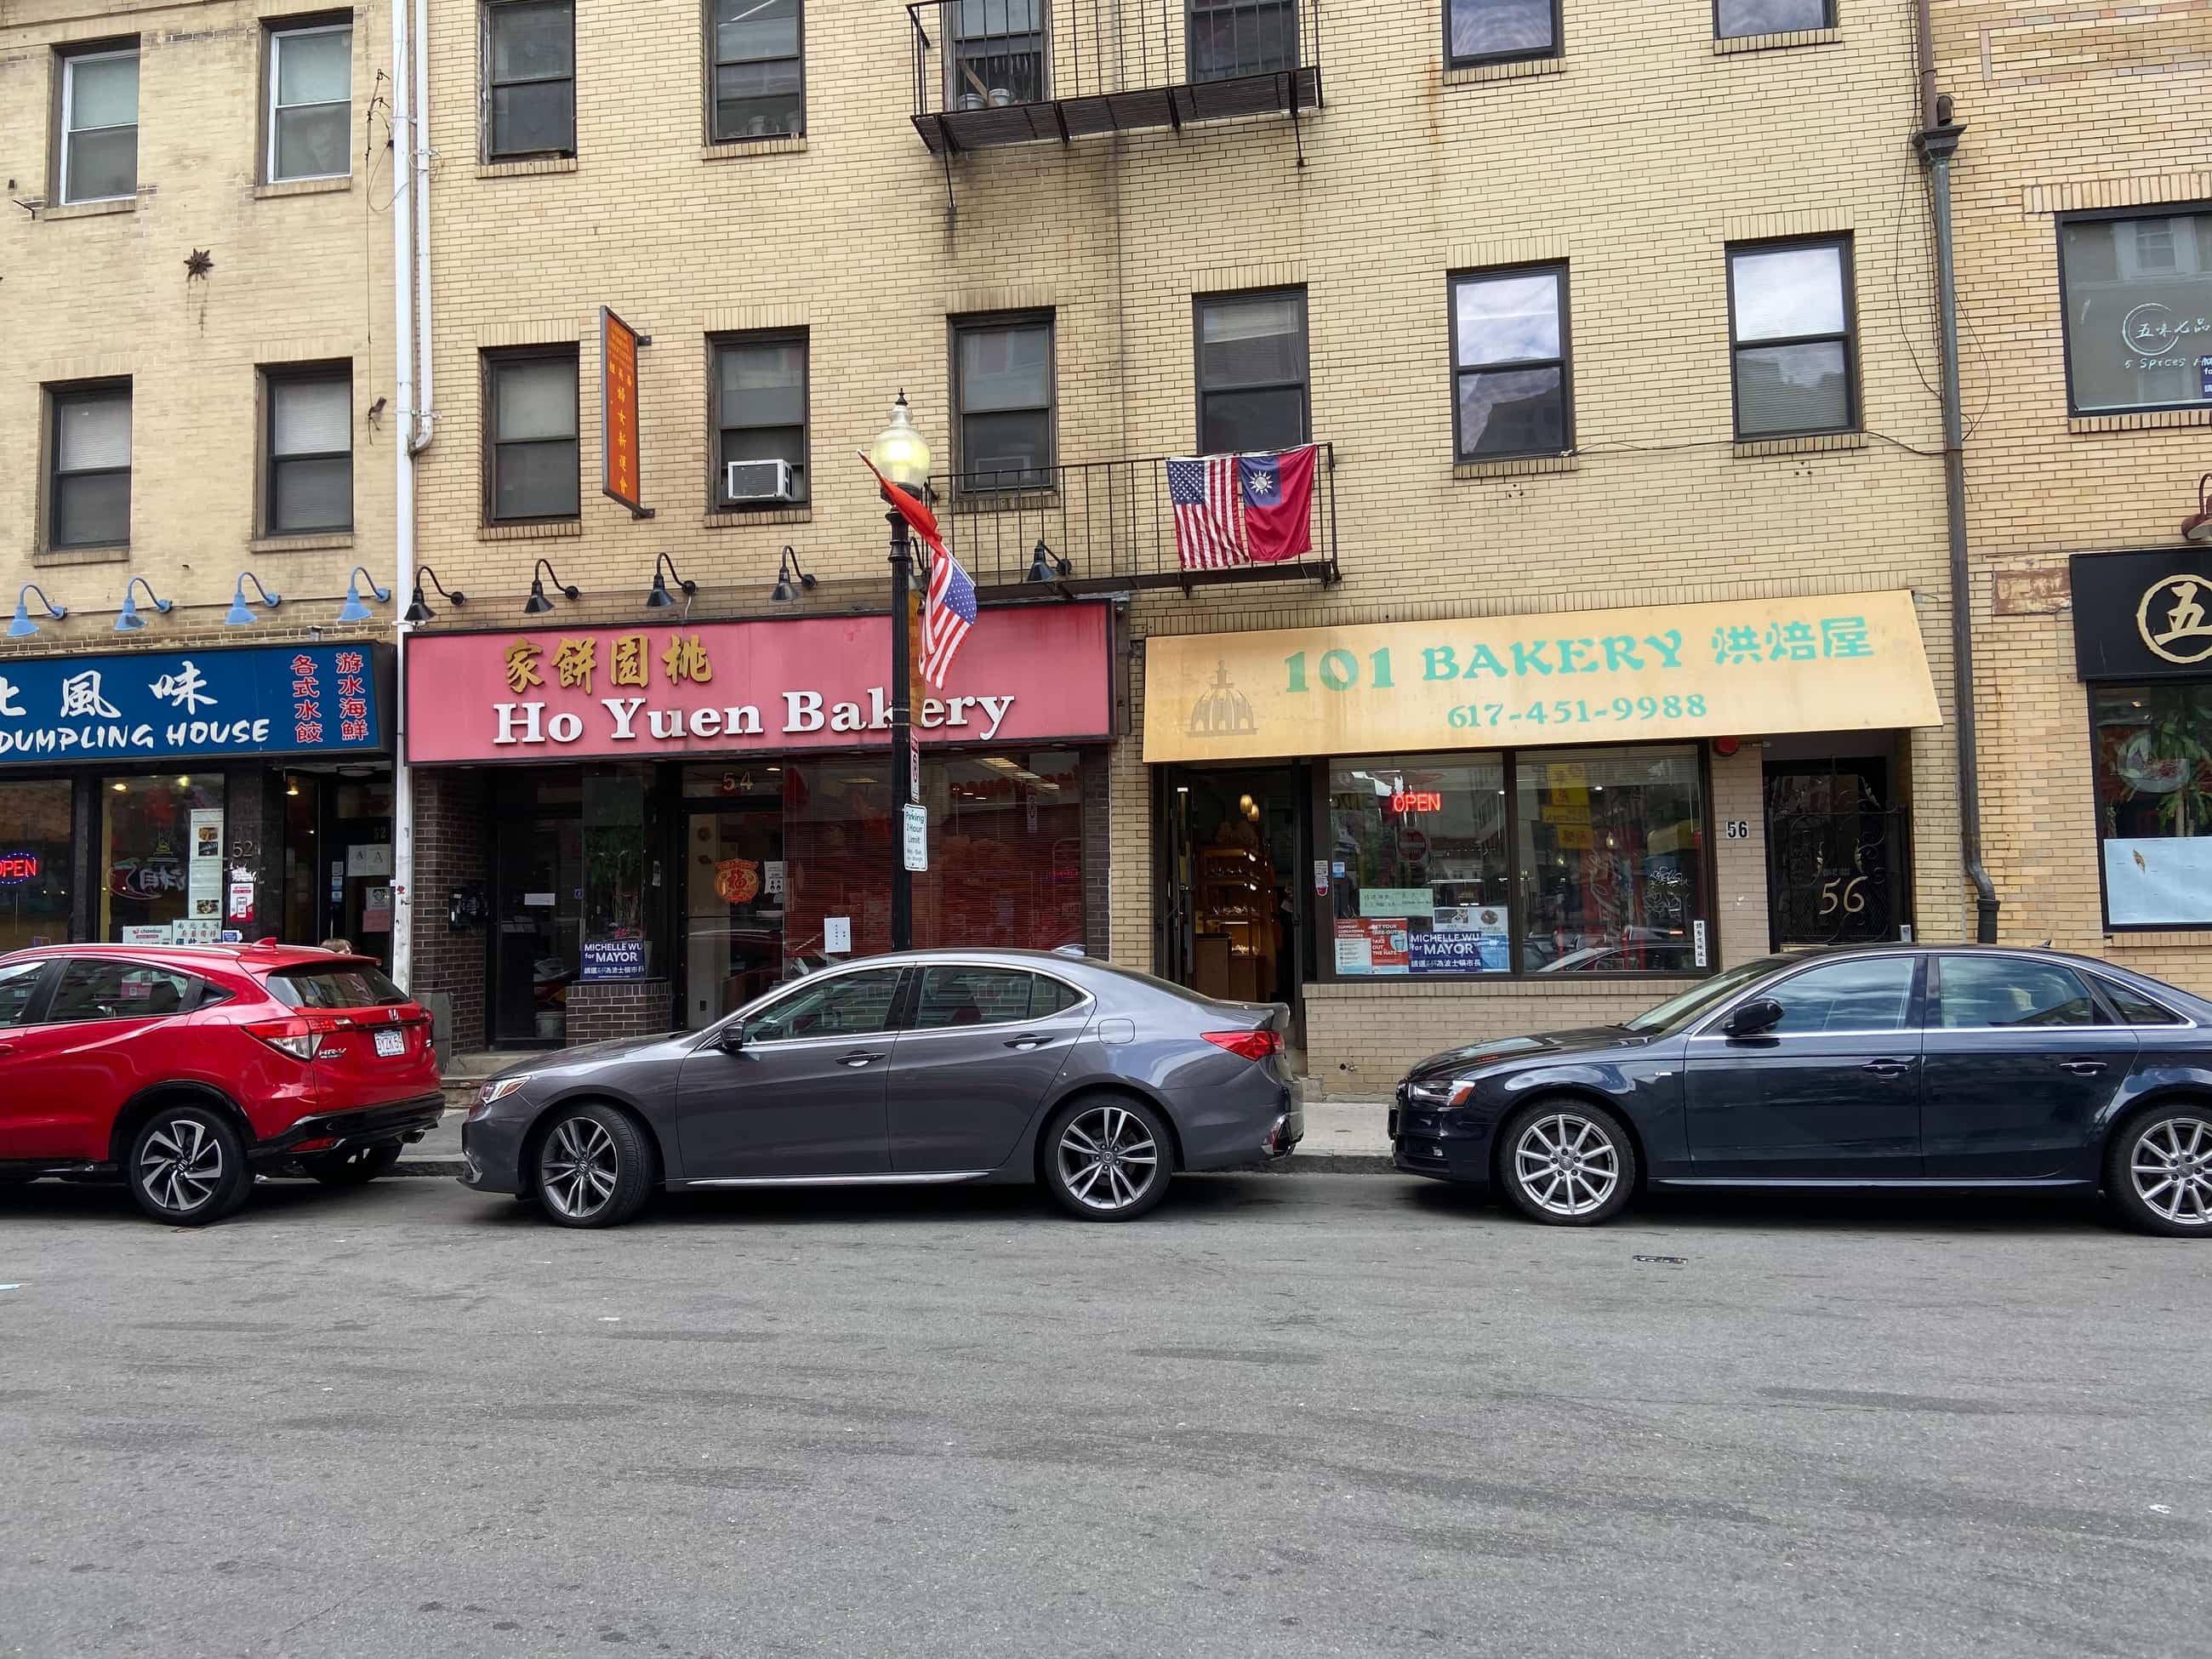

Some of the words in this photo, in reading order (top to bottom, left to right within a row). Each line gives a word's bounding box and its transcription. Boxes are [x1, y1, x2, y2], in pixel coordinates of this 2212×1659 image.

[2140, 357, 2186, 369] Spices
[2154, 581, 2212, 646] 五
[1712, 616, 1875, 665] 烘焙屋
[1283, 647, 1396, 693] 101
[1422, 629, 1684, 681] BAKERY
[290, 653, 323, 744] 各式水餃
[335, 652, 369, 741] 游水海鮮
[493, 700, 584, 744] Ho
[601, 697, 765, 739] Yuen
[781, 687, 1016, 740] Bakery
[1448, 693, 1707, 729] 617-451-9988
[0, 722, 154, 754] DUMPLING
[167, 718, 270, 746] HOUSE
[723, 771, 755, 791] 54
[1393, 793, 1442, 812] OPEN
[1728, 821, 1747, 838] 56
[232, 841, 253, 858] 52
[1819, 875, 1868, 915] 56
[584, 943, 627, 952] MICHELLE
[628, 942, 644, 951] WU
[1411, 933, 1460, 943] MICHELLE
[1462, 932, 1480, 942] WU
[1423, 943, 1474, 955] MAYOR
[596, 951, 639, 963] MAYOR
